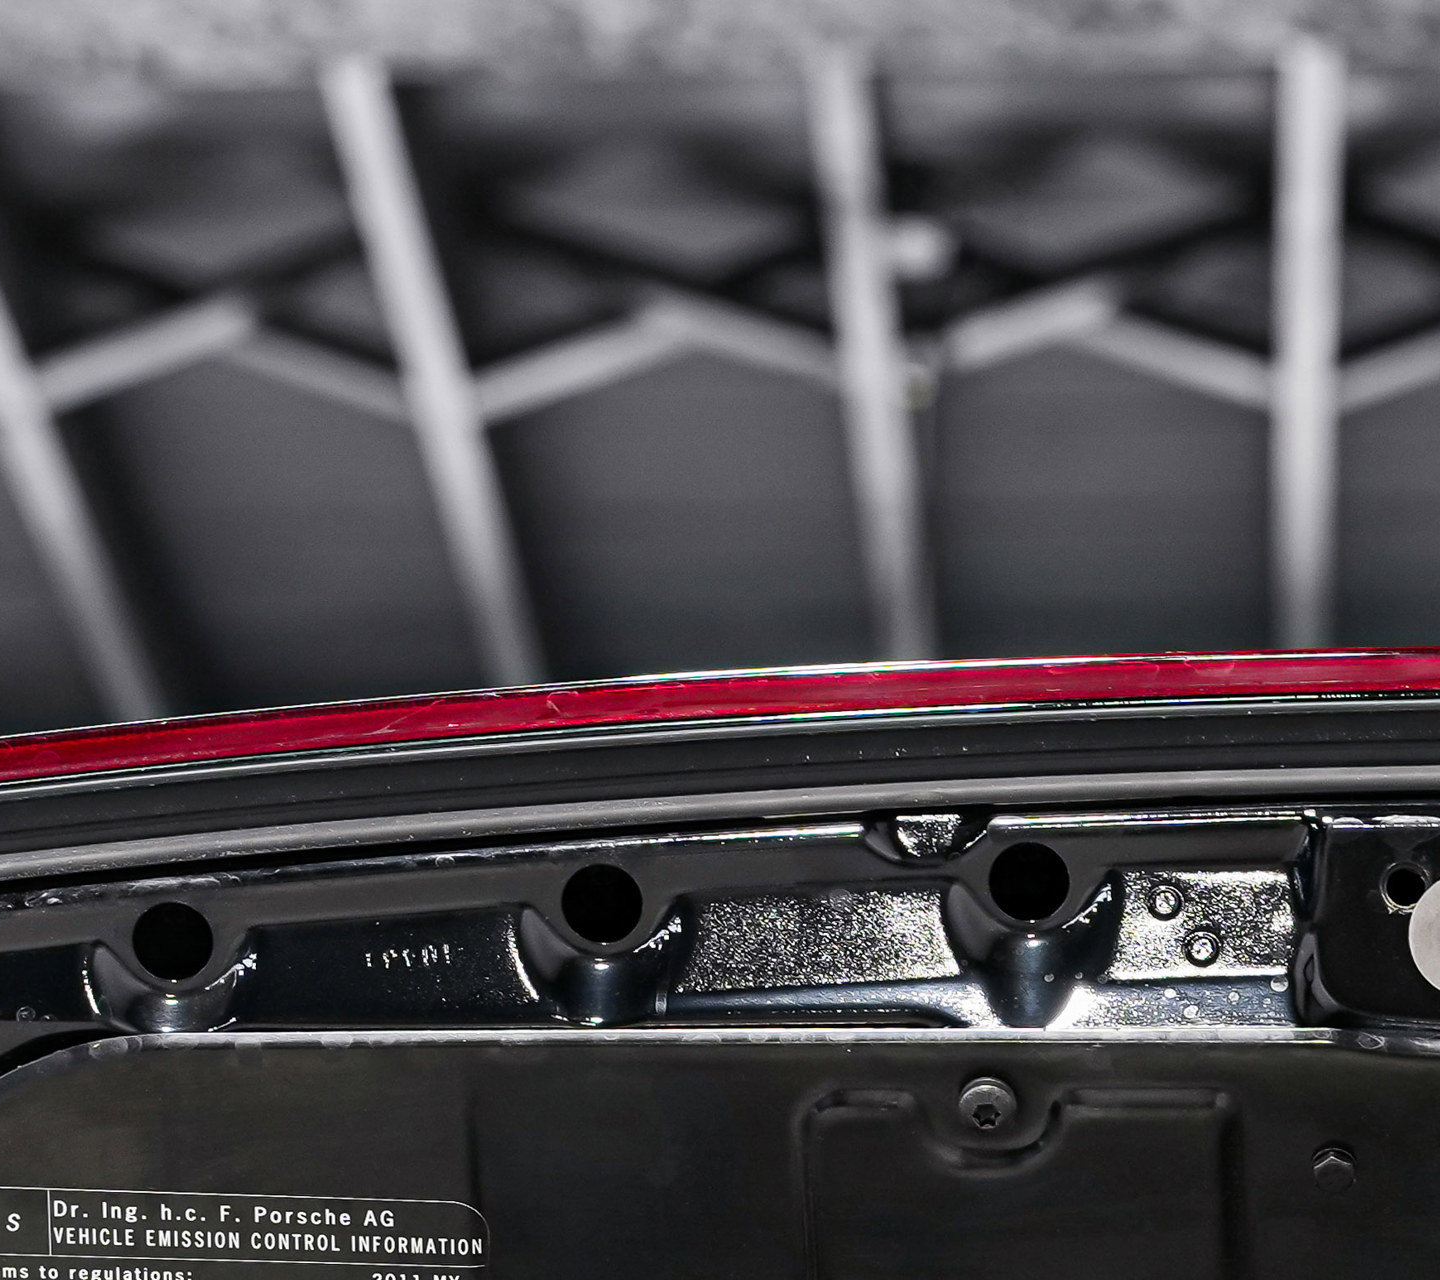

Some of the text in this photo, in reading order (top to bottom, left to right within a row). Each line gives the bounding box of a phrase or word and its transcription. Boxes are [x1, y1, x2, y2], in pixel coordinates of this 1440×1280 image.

[6, 1213, 20, 1231] S
[54, 1201, 393, 1226] Dr. Ing. h.c. F. Porsche AG
[54, 1227, 481, 1255] VEHICLE EMISSION CONTROL INFORMATION
[39, 1266, 58, 1279] to
